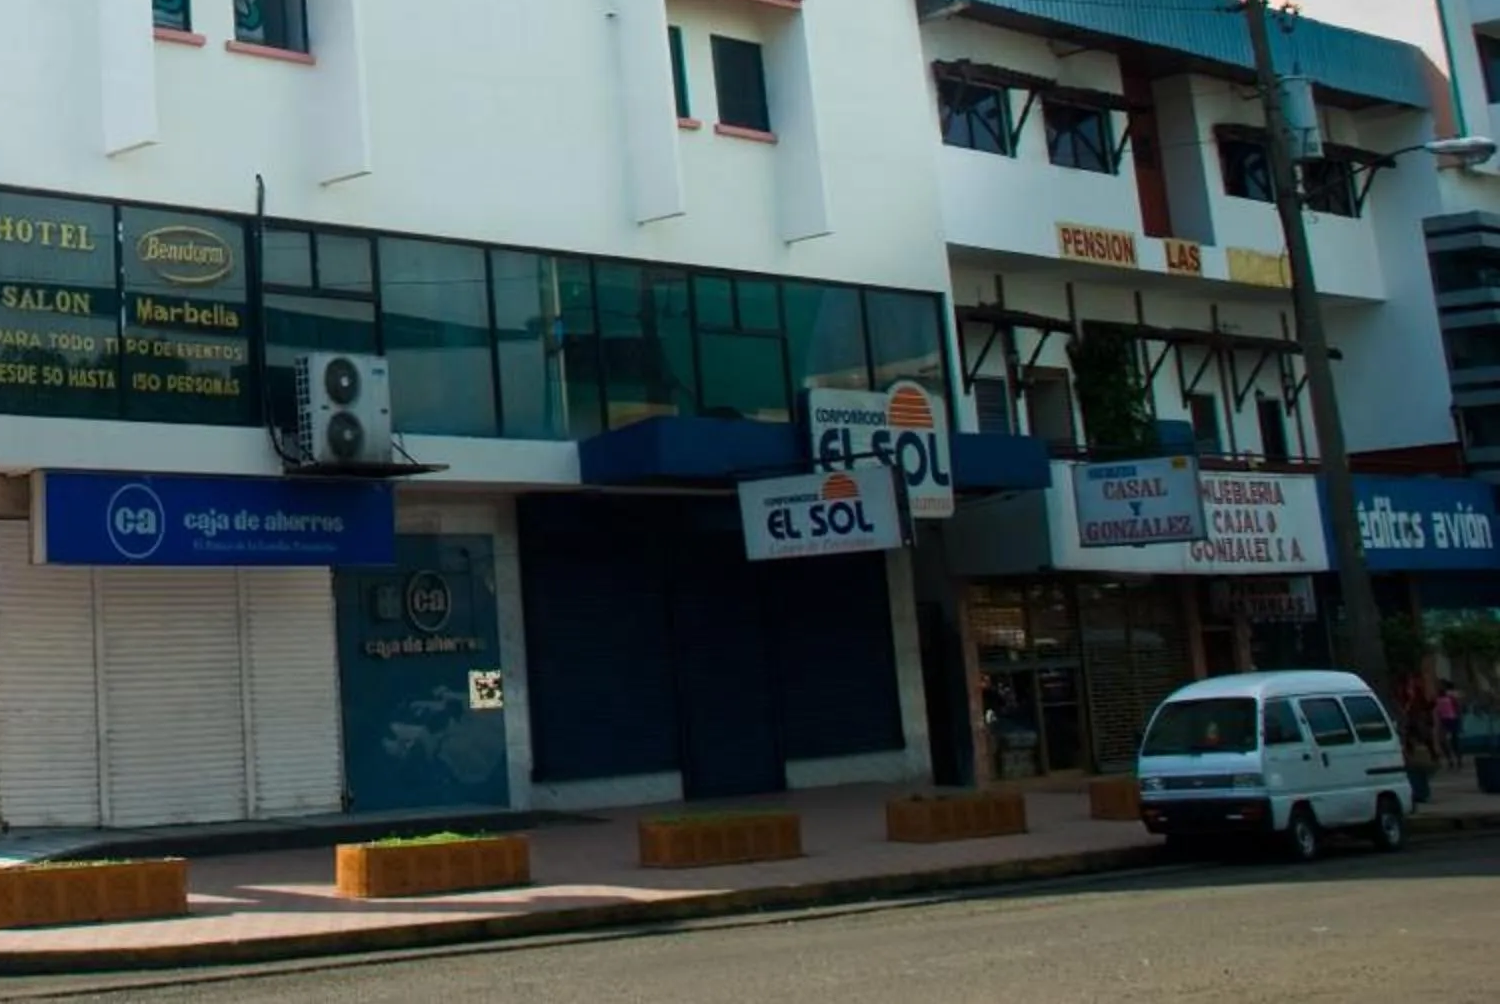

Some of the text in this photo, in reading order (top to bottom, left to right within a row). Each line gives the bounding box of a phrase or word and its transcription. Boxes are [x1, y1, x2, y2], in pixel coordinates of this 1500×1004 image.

[1061, 227, 1199, 272] PENSION LAS
[1, 285, 91, 314] SALON
[137, 297, 240, 328] Marbella
[49, 333, 95, 350] TODO
[154, 340, 172, 357] DE
[176, 342, 243, 361] EVENTOS
[42, 366, 63, 386] 50
[68, 368, 116, 390] HASTA
[132, 372, 161, 392] 150
[168, 376, 240, 395] PERSONAS
[871, 430, 949, 487] SOL
[1102, 477, 1169, 498] CASAL
[115, 505, 156, 536] ca
[183, 508, 345, 538] caja de ahorros
[767, 508, 802, 540] EL
[809, 500, 874, 536] SOL
[1128, 501, 1140, 517] Y
[1086, 514, 1194, 542] GONZALEZ
[414, 589, 446, 612] ca
